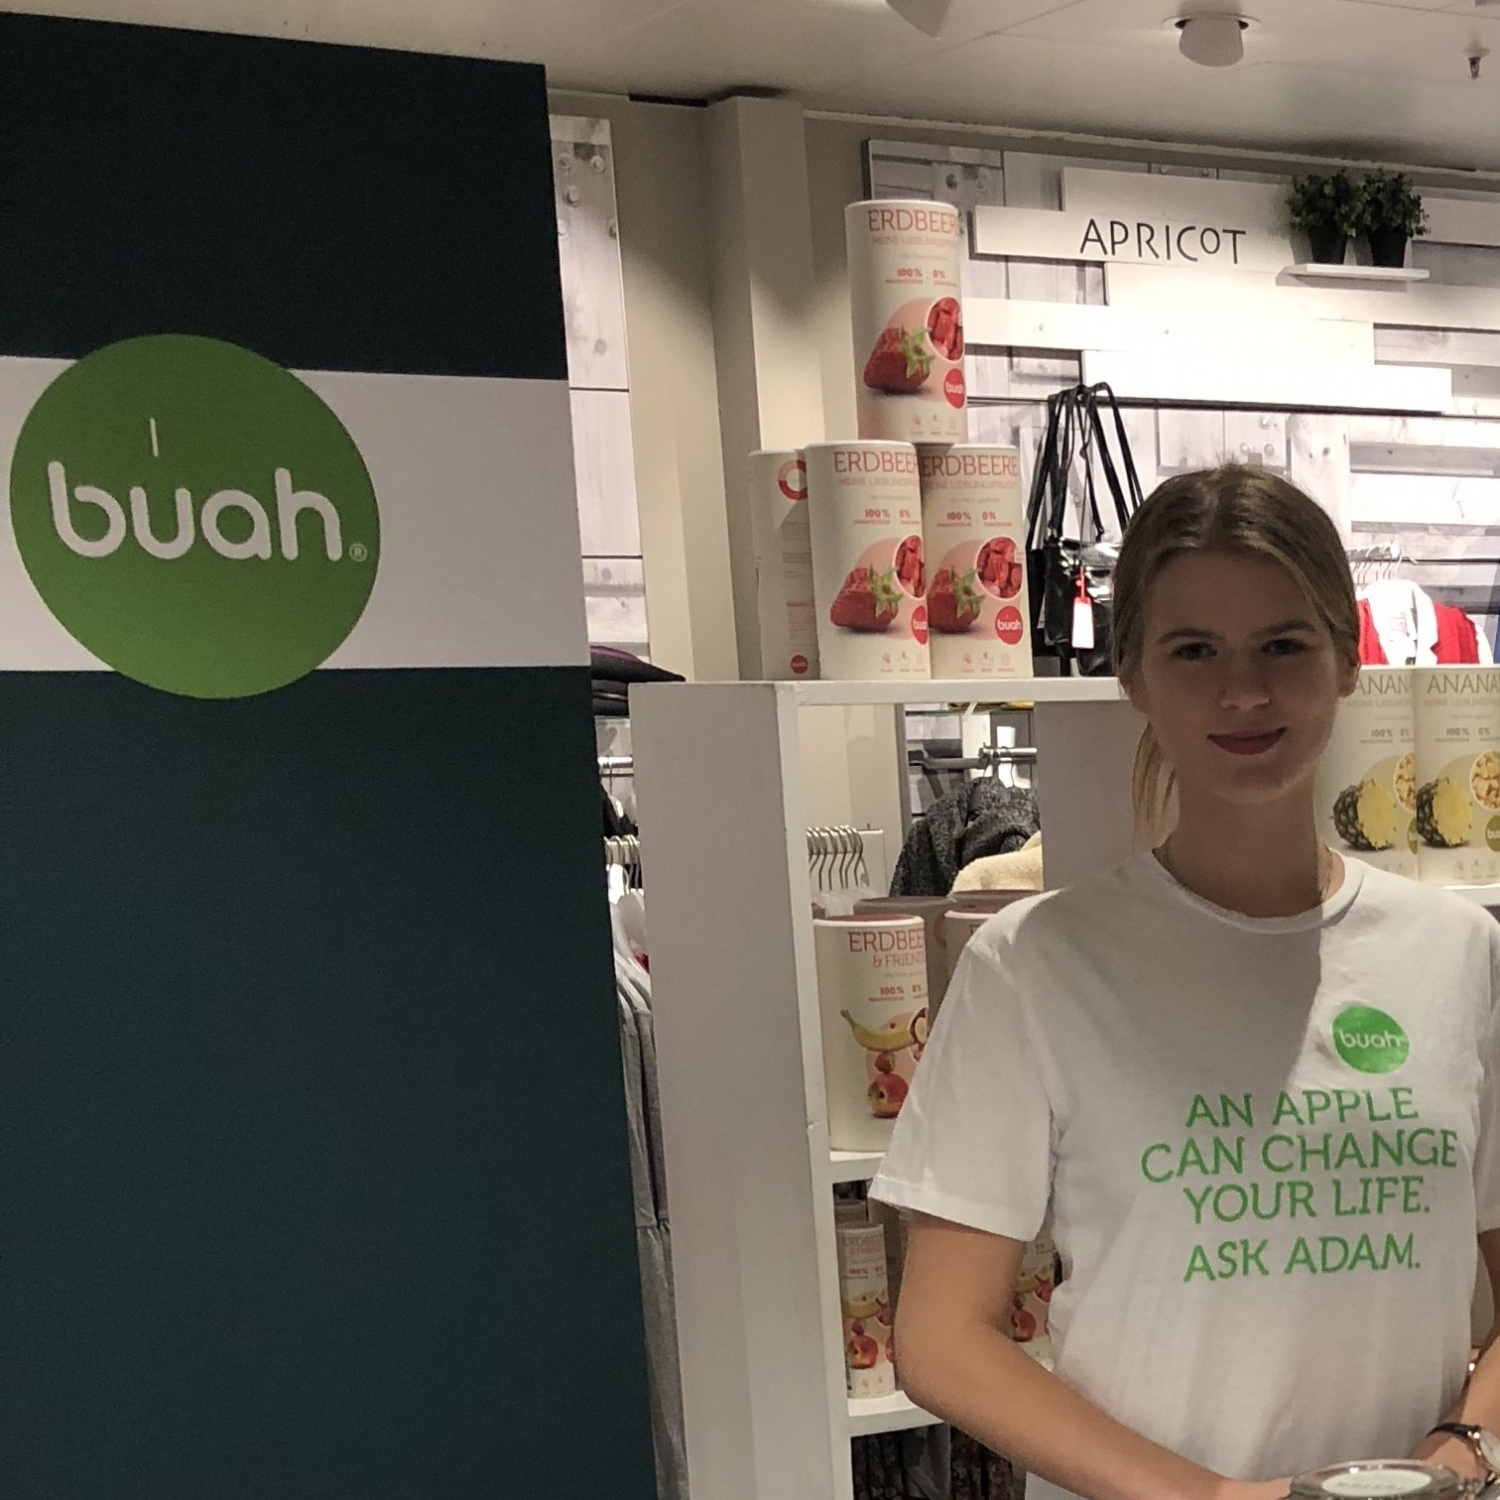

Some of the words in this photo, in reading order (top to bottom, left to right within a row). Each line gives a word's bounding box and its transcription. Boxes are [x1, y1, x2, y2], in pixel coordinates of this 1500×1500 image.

[1080, 218, 1247, 264] APRICOT
[1338, 1027, 1402, 1049] buah
[1185, 1093, 1253, 1128] AN
[1272, 1087, 1419, 1126] APPLE
[1141, 1136, 1245, 1183] CAN
[1261, 1127, 1458, 1173] CHANGE
[1183, 1180, 1317, 1224] YOUR
[1332, 1175, 1430, 1216] LIFE.
[1183, 1238, 1269, 1283] ASK
[1283, 1232, 1421, 1274] ADAM.
